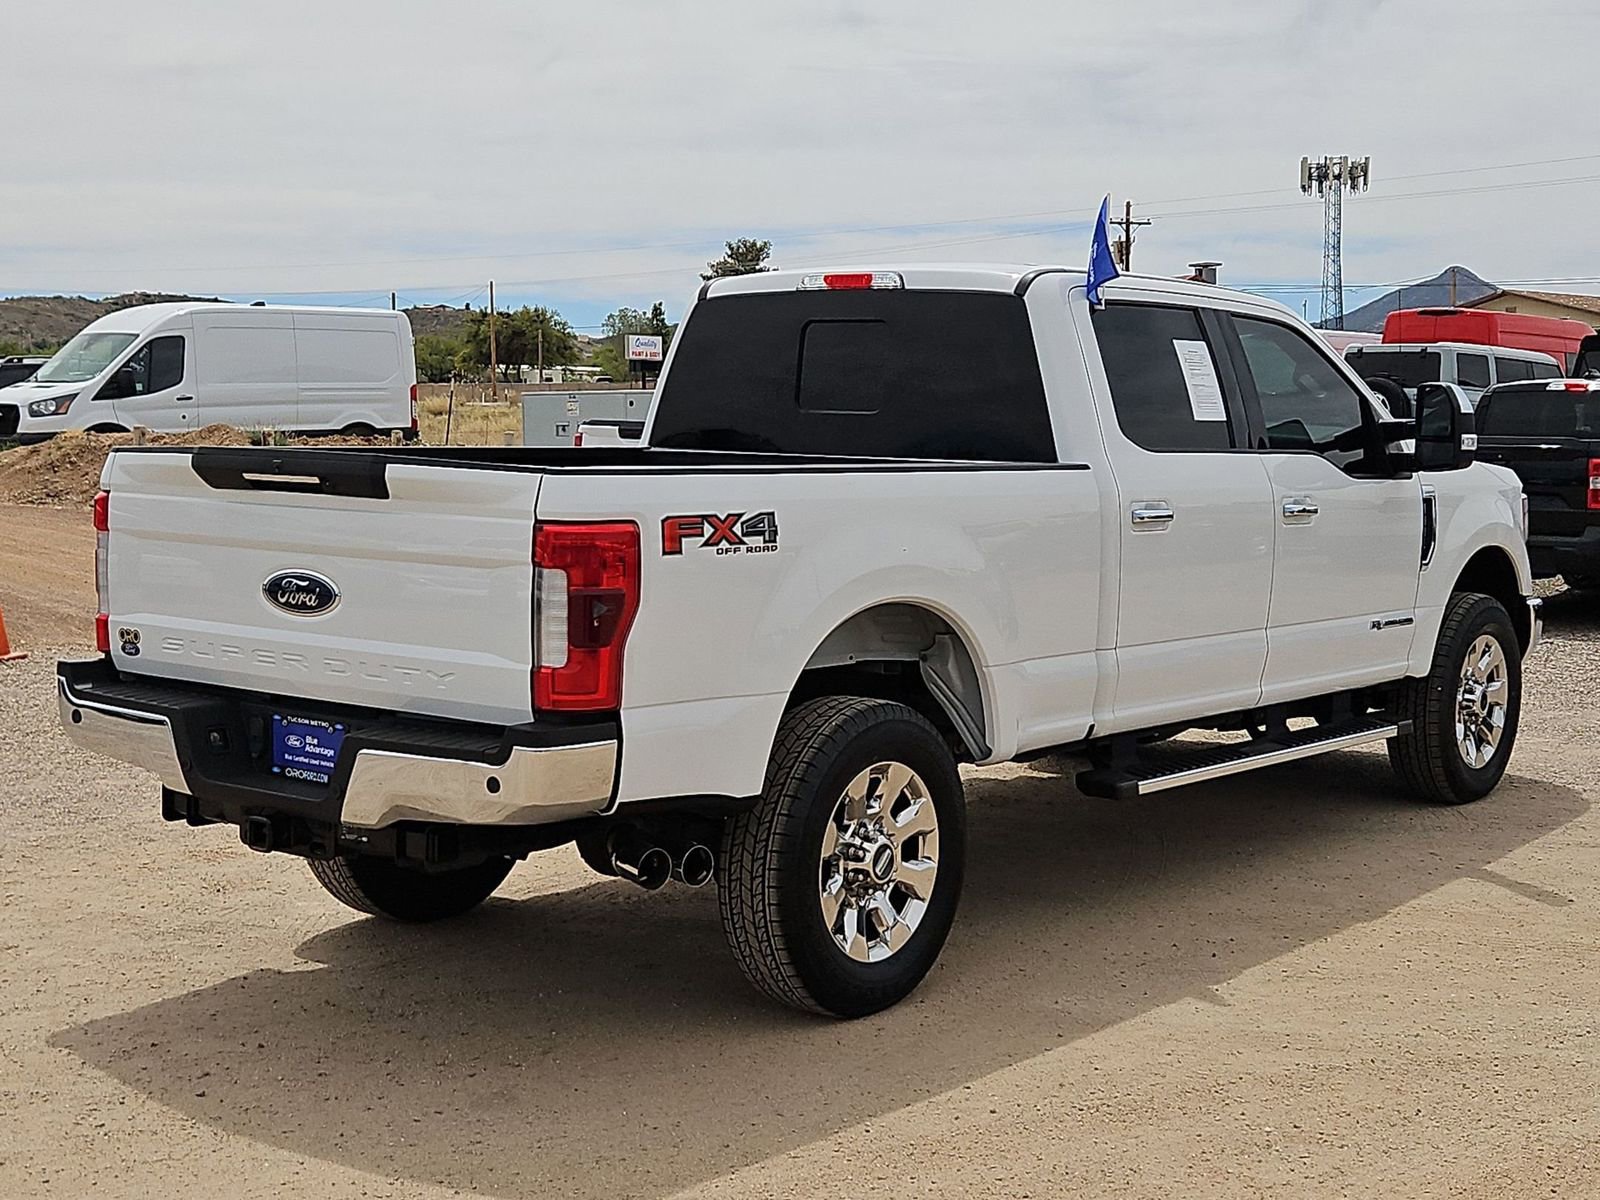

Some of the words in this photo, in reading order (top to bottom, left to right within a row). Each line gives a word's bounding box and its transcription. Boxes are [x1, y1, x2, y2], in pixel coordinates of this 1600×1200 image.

[661, 511, 778, 556] FX4
[716, 547, 741, 556] OFF
[746, 545, 778, 554] ROAD
[277, 578, 320, 607] Ford
[118, 628, 141, 644] ORO
[162, 637, 309, 672] SUPER
[323, 657, 456, 689] DUTY
[287, 716, 309, 725] TUCSON
[310, 719, 330, 728] METRO
[305, 735, 318, 745] Blue
[305, 744, 335, 757] Advantage
